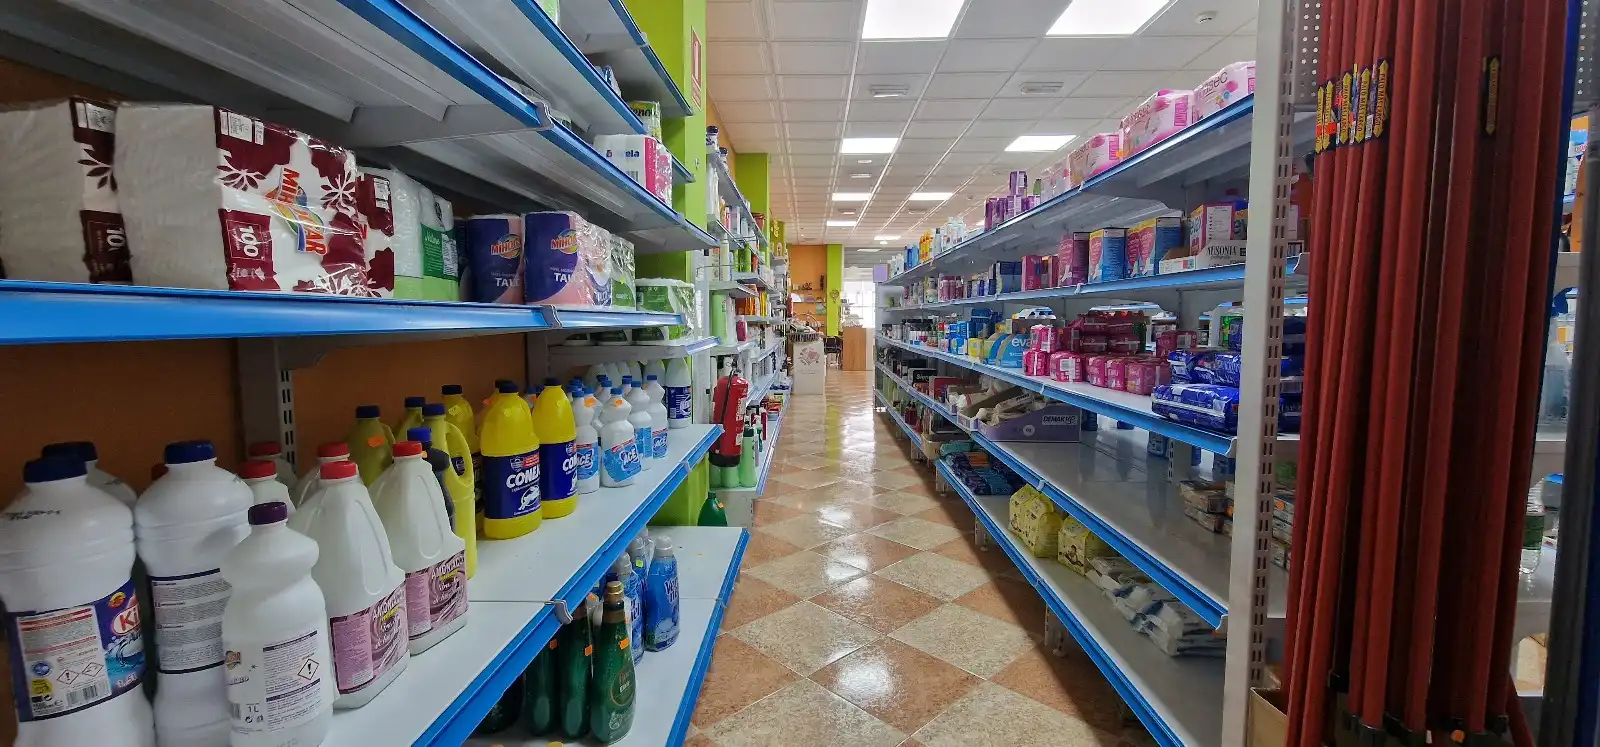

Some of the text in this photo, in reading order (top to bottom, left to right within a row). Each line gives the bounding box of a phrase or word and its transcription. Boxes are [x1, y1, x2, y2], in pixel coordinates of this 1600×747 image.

[106, 227, 127, 252] 10
[240, 225, 260, 258] 100
[623, 447, 638, 465] ACE
